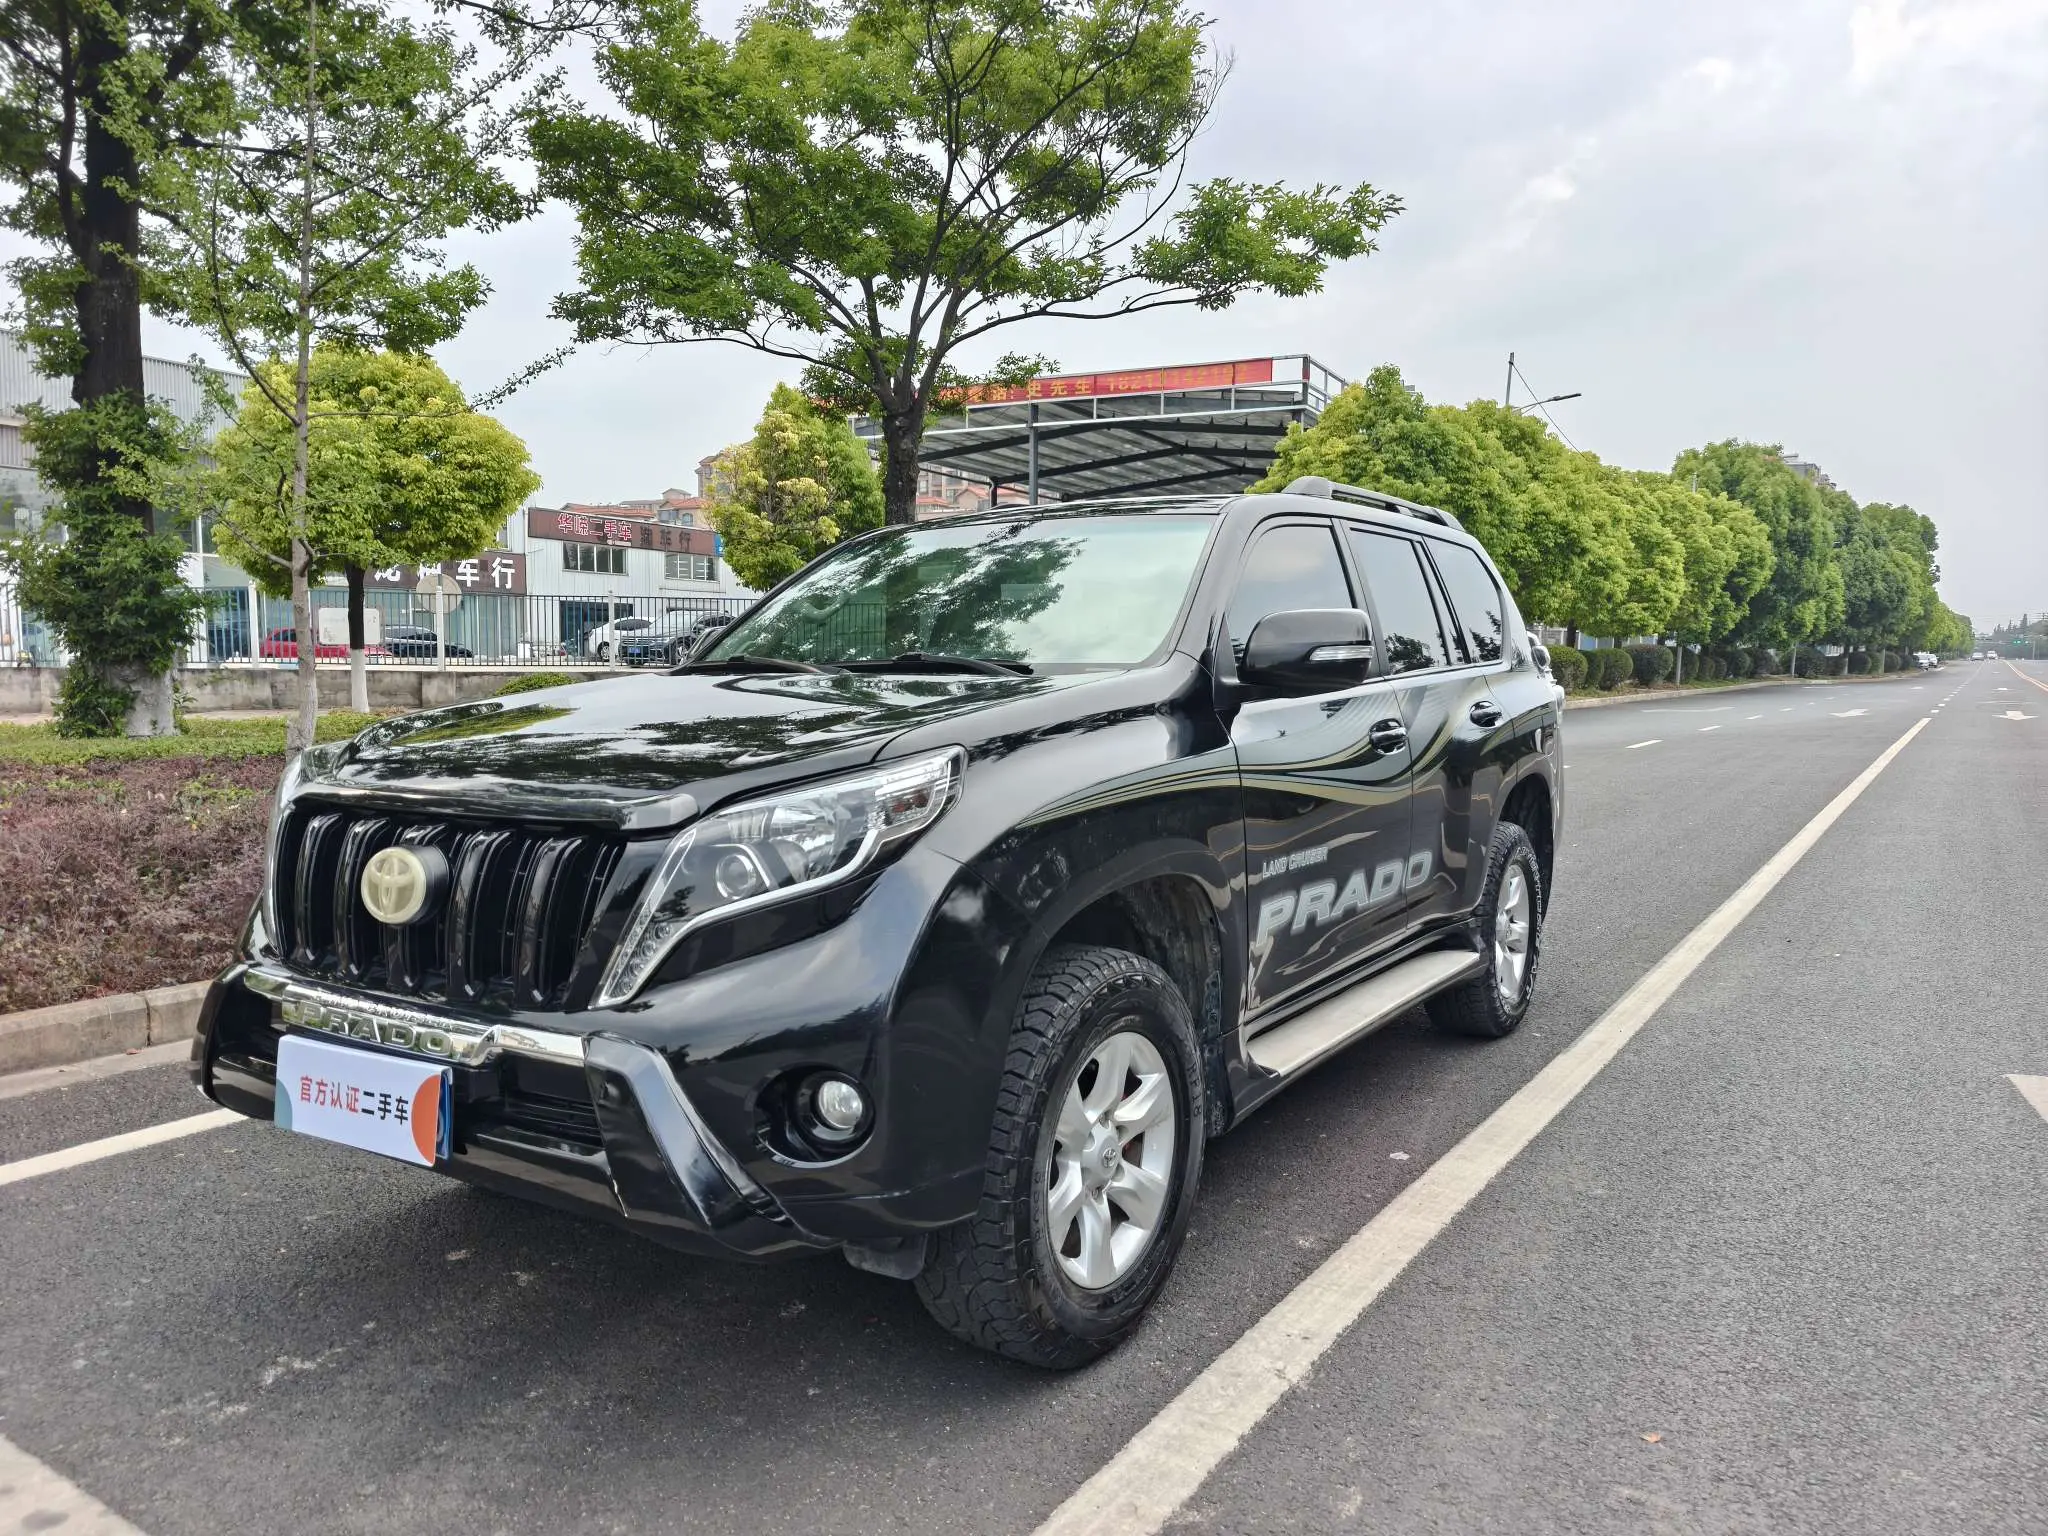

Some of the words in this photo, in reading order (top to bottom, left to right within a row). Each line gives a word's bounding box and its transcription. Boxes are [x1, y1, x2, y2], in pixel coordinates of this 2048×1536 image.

[1262, 856, 1287, 879] LAND
[1256, 850, 1433, 947] PRADO
[299, 1001, 453, 1056] PRADO
[299, 1076, 409, 1125] 官方认证二手车
